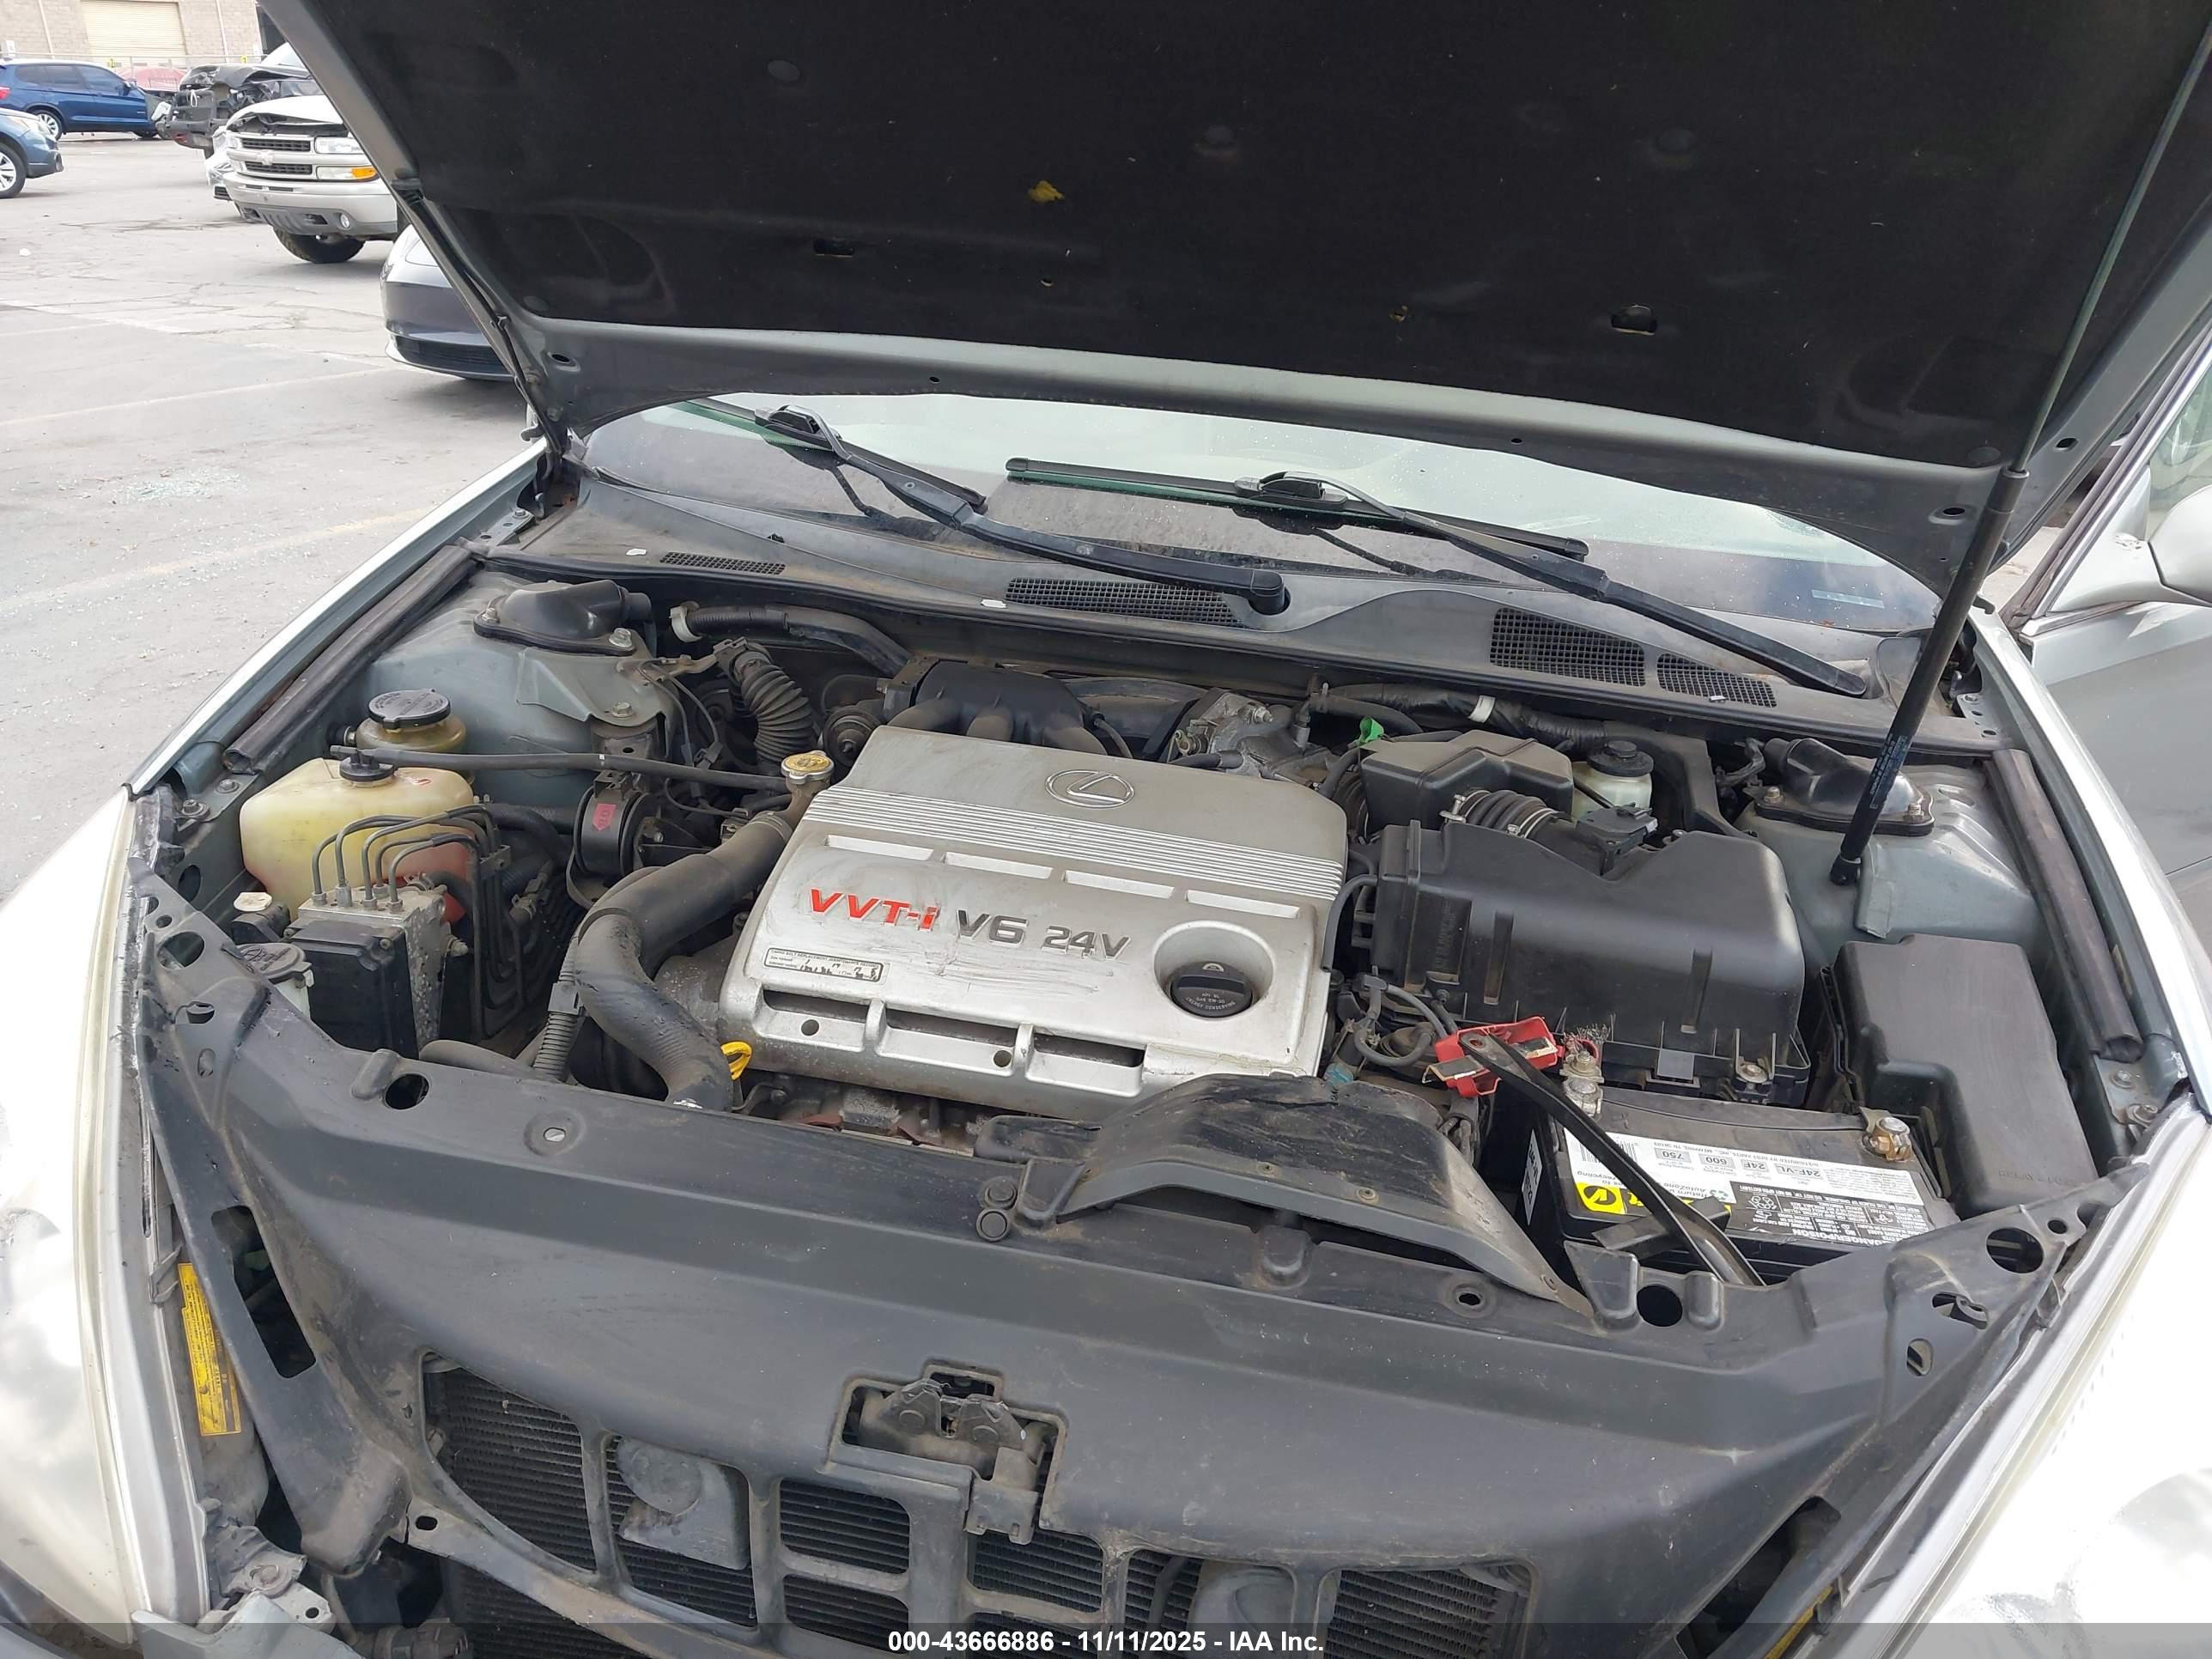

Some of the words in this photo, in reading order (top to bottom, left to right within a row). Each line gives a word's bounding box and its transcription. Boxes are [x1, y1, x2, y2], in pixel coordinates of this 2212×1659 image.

[810, 888, 940, 932] VVT-i
[955, 909, 1029, 945] V6
[1040, 925, 1132, 961] 24V
[1661, 1150, 1684, 1159] 750
[1705, 1156, 1727, 1164] 600
[1743, 1161, 1766, 1170] 24F
[1775, 1165, 1820, 1176] 24F-VL
[1577, 1170, 1615, 1180] recycling
[1662, 1182, 1705, 1193] AutoZone
